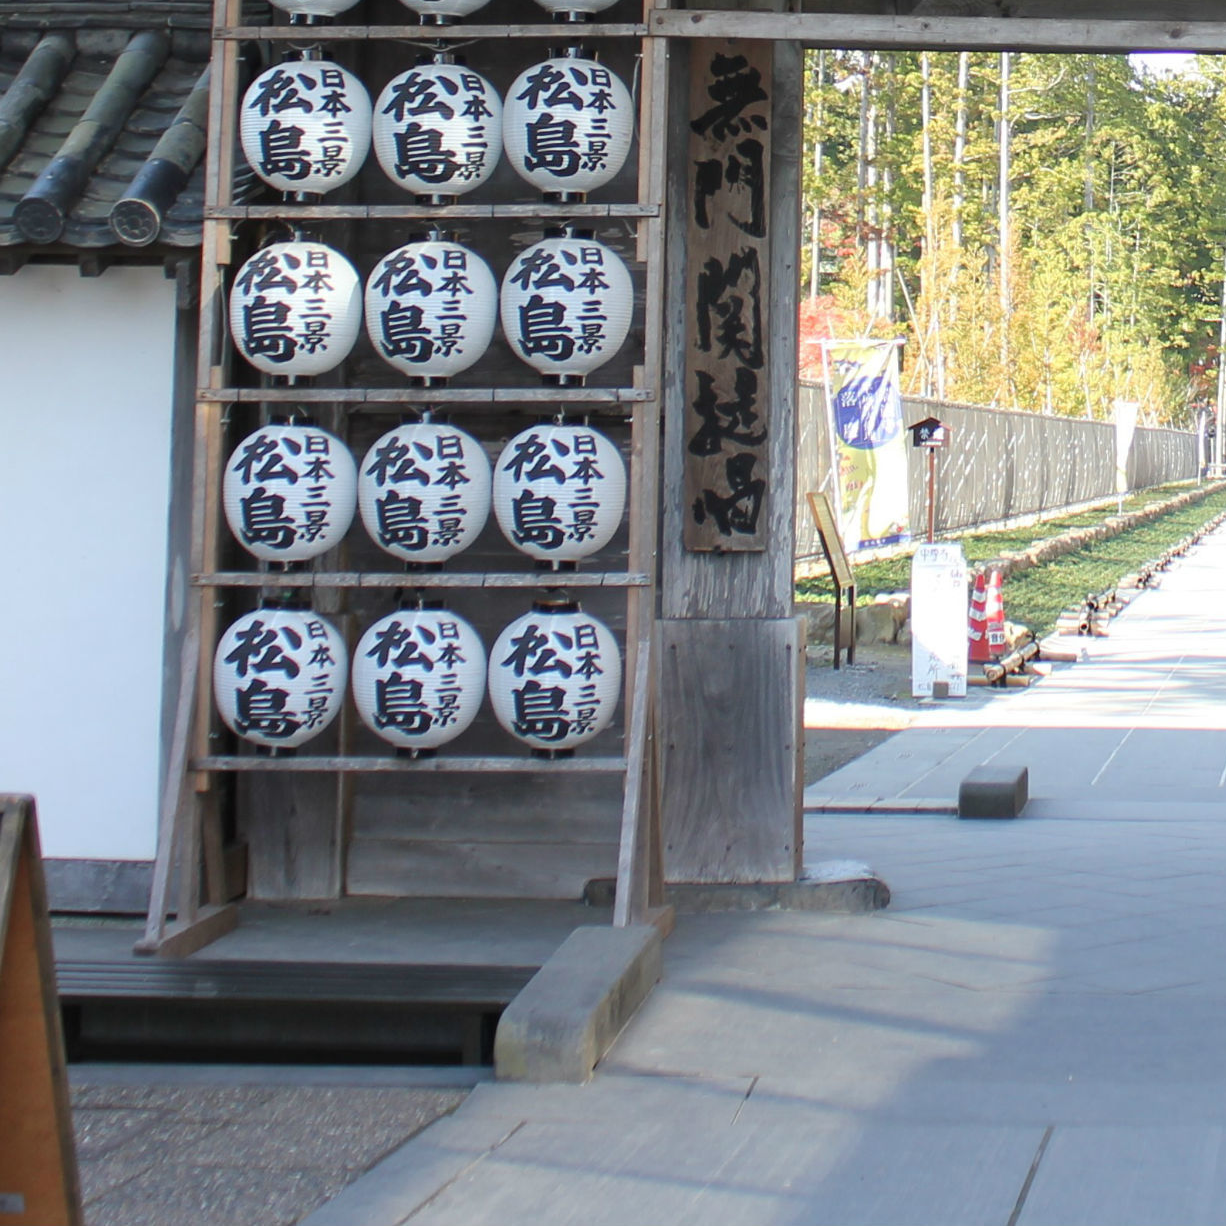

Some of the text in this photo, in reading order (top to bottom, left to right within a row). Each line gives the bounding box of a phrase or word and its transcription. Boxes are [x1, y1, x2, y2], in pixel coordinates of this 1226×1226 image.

[250, 69, 319, 180] 松島
[313, 69, 352, 176] 日本三景
[381, 72, 459, 183] 松島
[454, 73, 494, 180] 日本三景
[516, 64, 589, 177] 松島
[580, 67, 617, 171] 日本三景
[236, 250, 301, 362] 松島
[298, 250, 335, 354] 日本三景
[372, 250, 438, 364] 松島
[433, 250, 475, 356] 日本三景
[510, 247, 578, 361] 松島
[573, 247, 610, 354] 日本三景
[232, 434, 301, 549] 松島
[295, 434, 335, 542] 日本三景
[365, 436, 434, 551] 松島
[431, 434, 470, 545] 日本三景
[502, 434, 570, 549] 松島
[566, 434, 604, 543] 日本三景
[225, 619, 302, 734] 松島
[299, 621, 336, 727] 日本三景
[366, 620, 435, 734] 松島
[433, 621, 467, 725] 日本三景
[500, 624, 573, 740] 松島
[569, 624, 603, 734] 日本三景
